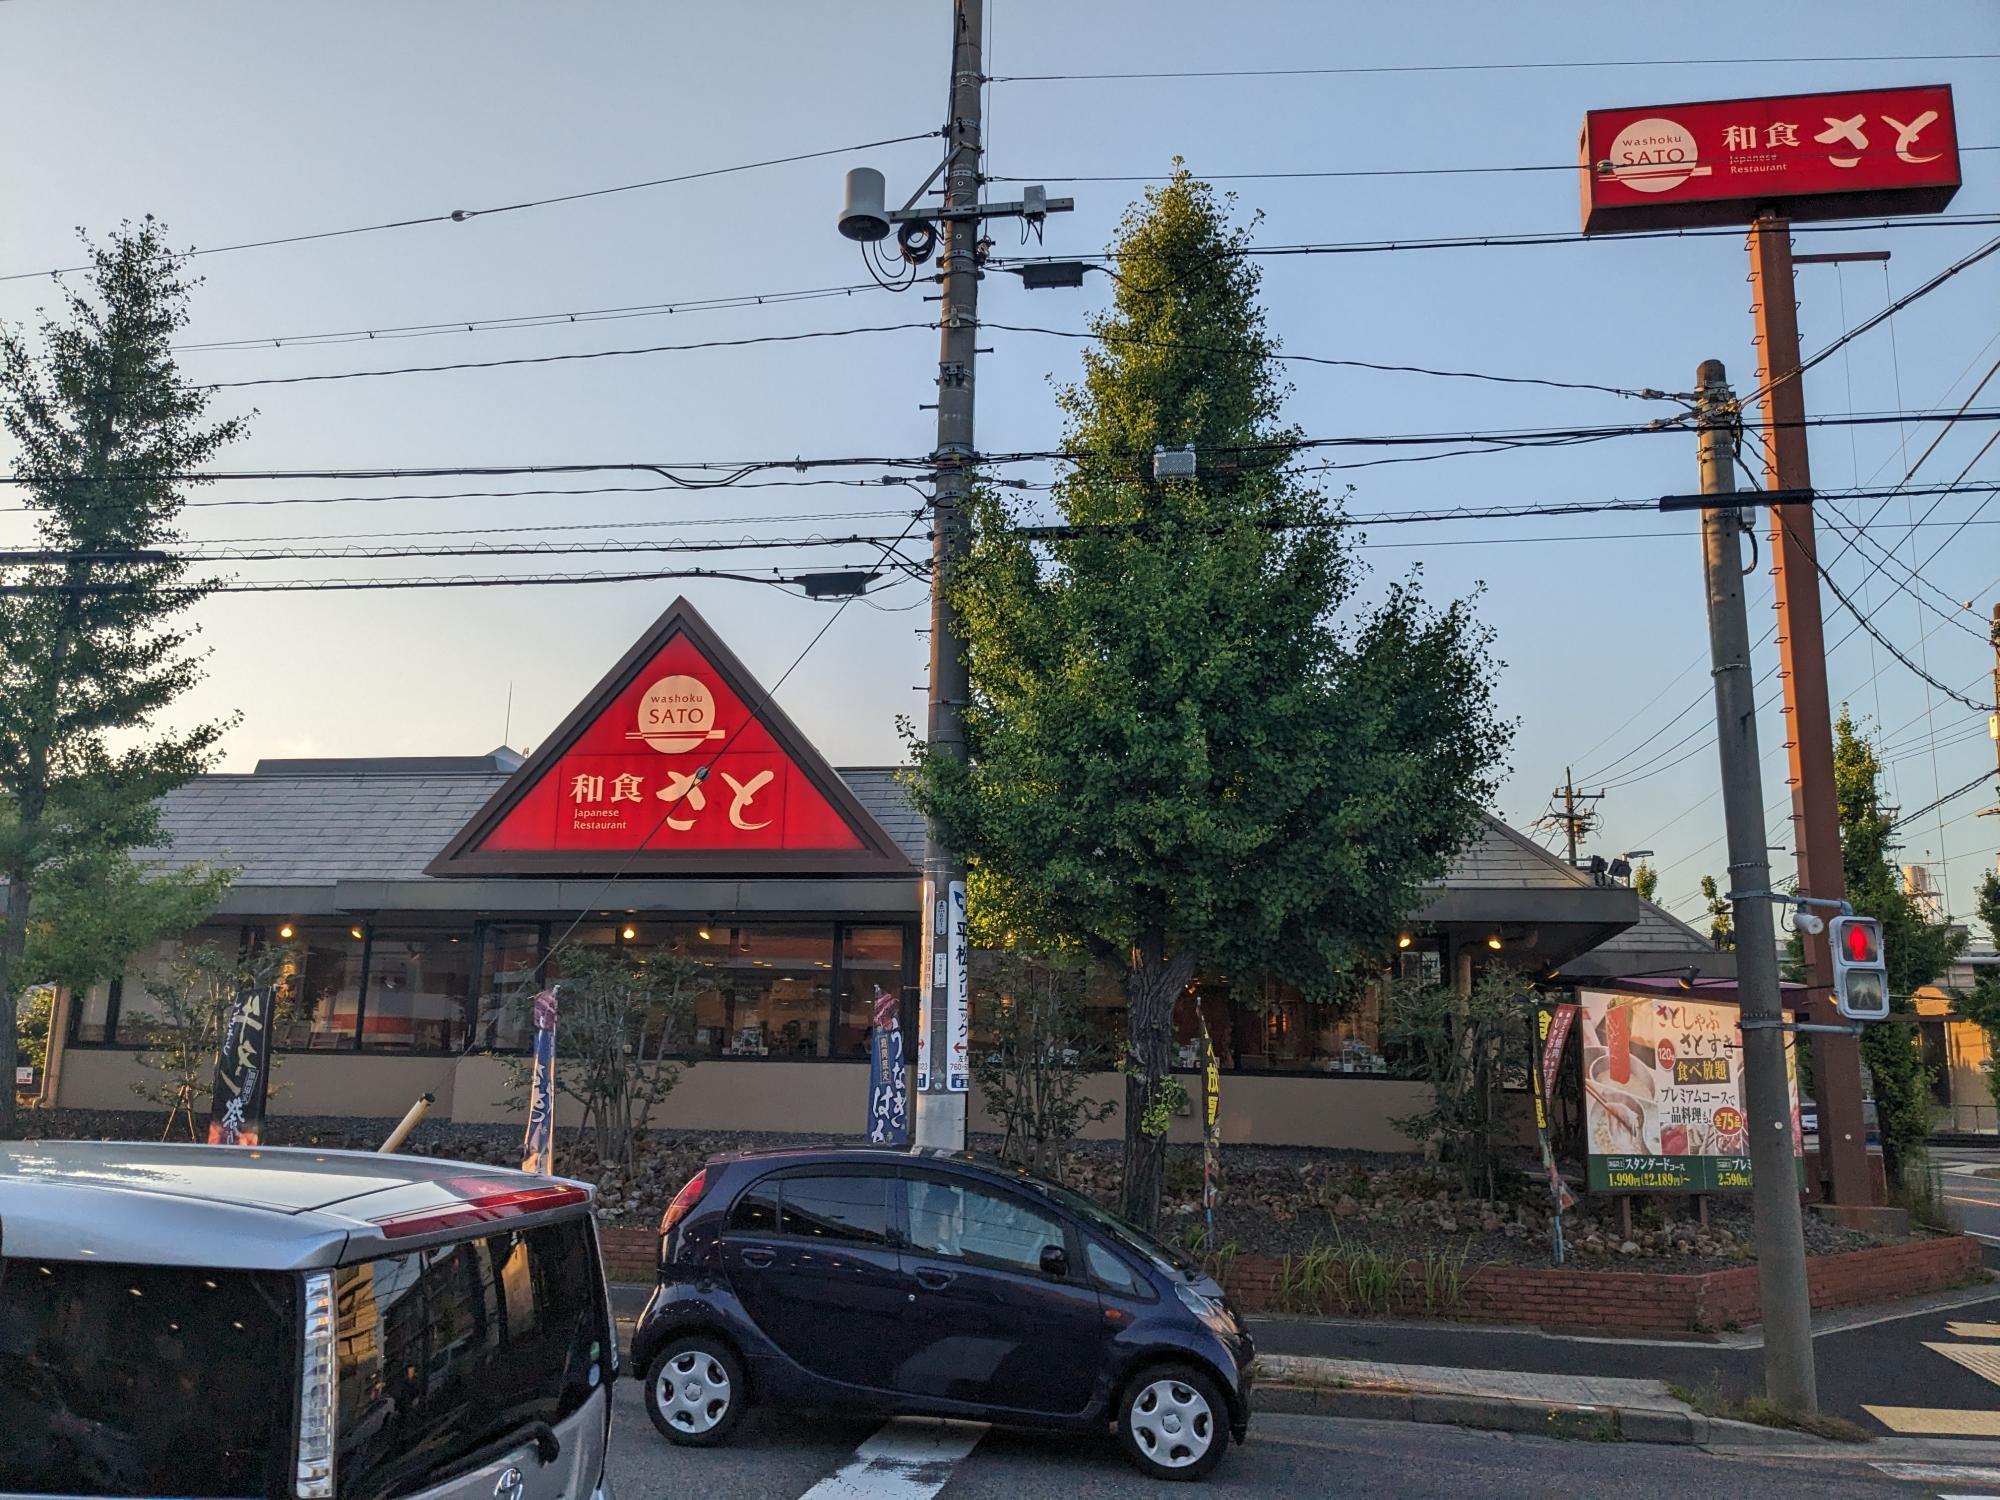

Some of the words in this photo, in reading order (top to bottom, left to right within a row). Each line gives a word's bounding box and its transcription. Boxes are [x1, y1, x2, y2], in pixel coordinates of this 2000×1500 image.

[1622, 135, 1682, 146] washoku
[1721, 121, 1801, 152] 和食
[1814, 110, 1944, 168] さと
[1622, 148, 1685, 167] SATO
[1729, 153, 1777, 164] Japanese
[1730, 163, 1788, 175] Restaurant
[650, 693, 703, 703] washoku
[648, 708, 704, 724] SATO
[569, 772, 645, 803] 和食
[655, 770, 775, 831] さと
[574, 808, 619, 820] Japanese
[573, 820, 627, 830] Restaurant
[1656, 1005, 1720, 1032] さとしゃぶ
[1680, 1033, 1734, 1059] さとすき
[1677, 1060, 1727, 1082] 食べ放題
[1661, 1087, 1735, 1107] プレミアムコースで
